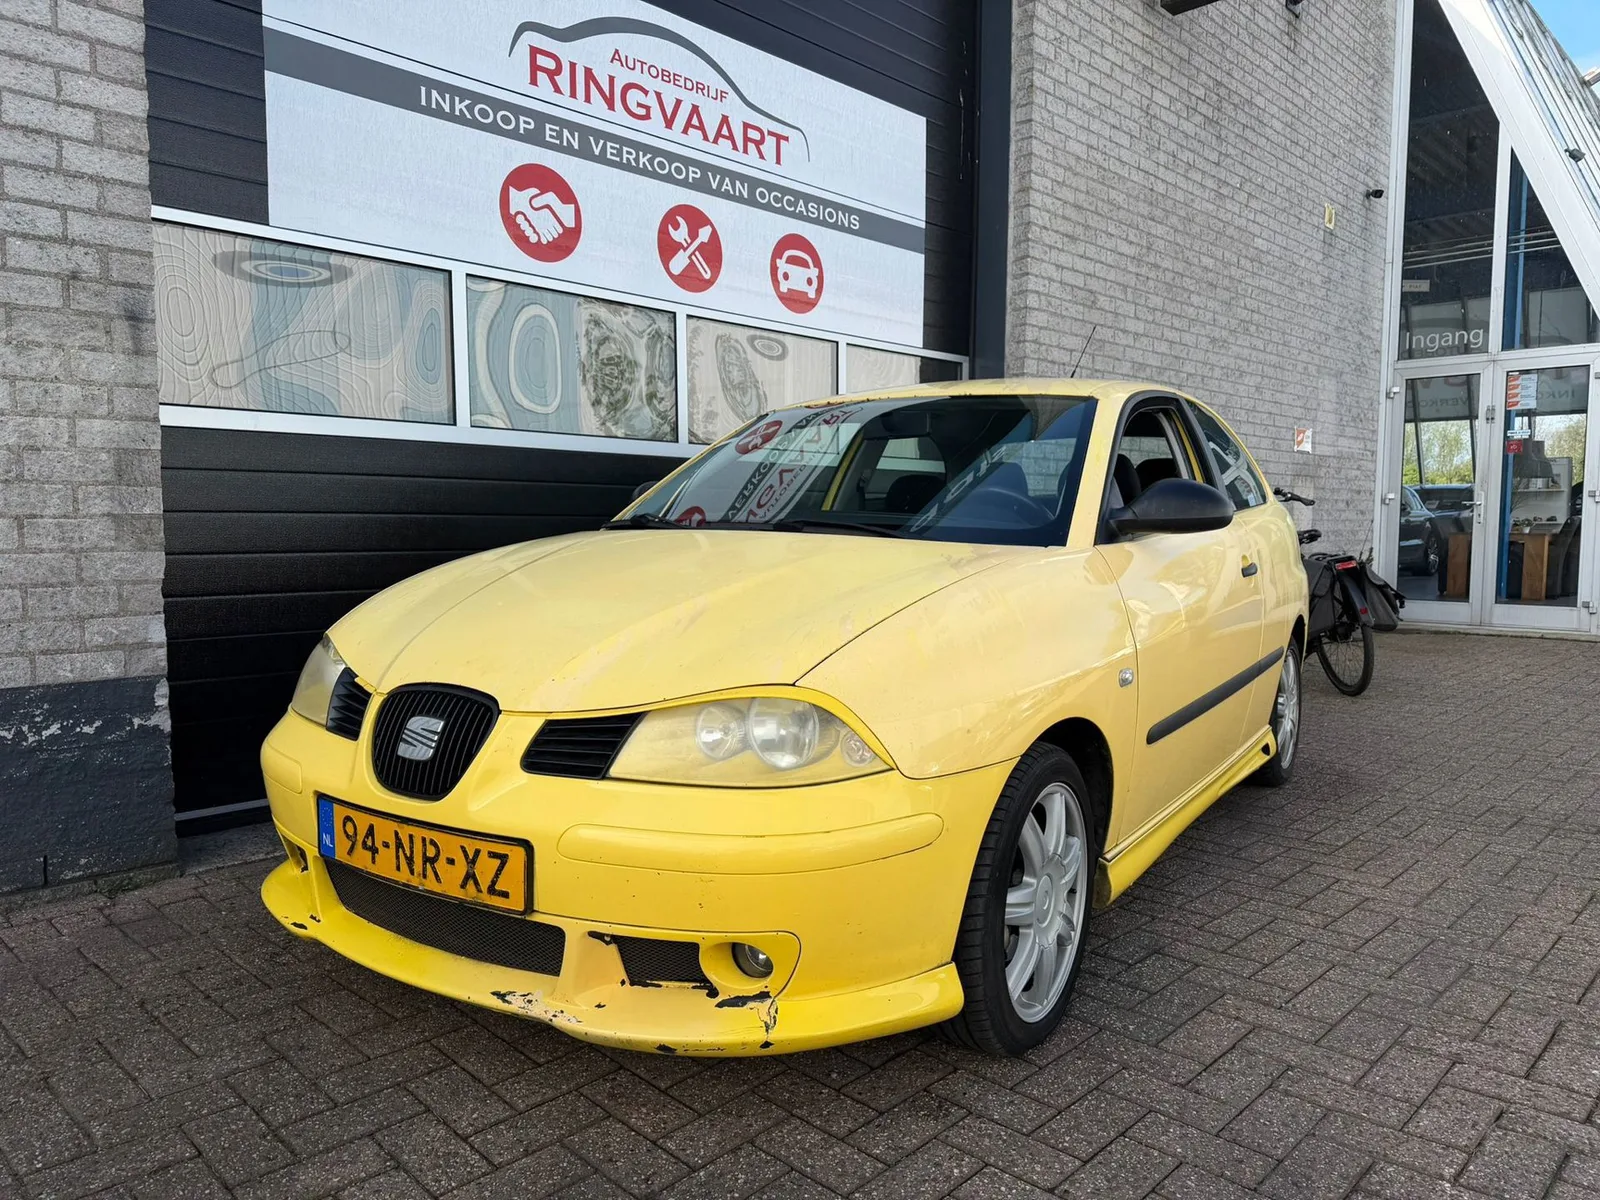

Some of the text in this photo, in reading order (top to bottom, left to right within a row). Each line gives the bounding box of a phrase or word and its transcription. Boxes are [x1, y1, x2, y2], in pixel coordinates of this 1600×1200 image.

[528, 45, 790, 166] RINGVAART
[609, 48, 729, 103] AUTOBEDRIJF
[420, 85, 860, 230] INKOOP EN VERKOOP VAN OCCASIONS
[1405, 328, 1484, 352] Ingang
[322, 833, 334, 848] NL
[342, 814, 510, 900] 94-NR-XZ
